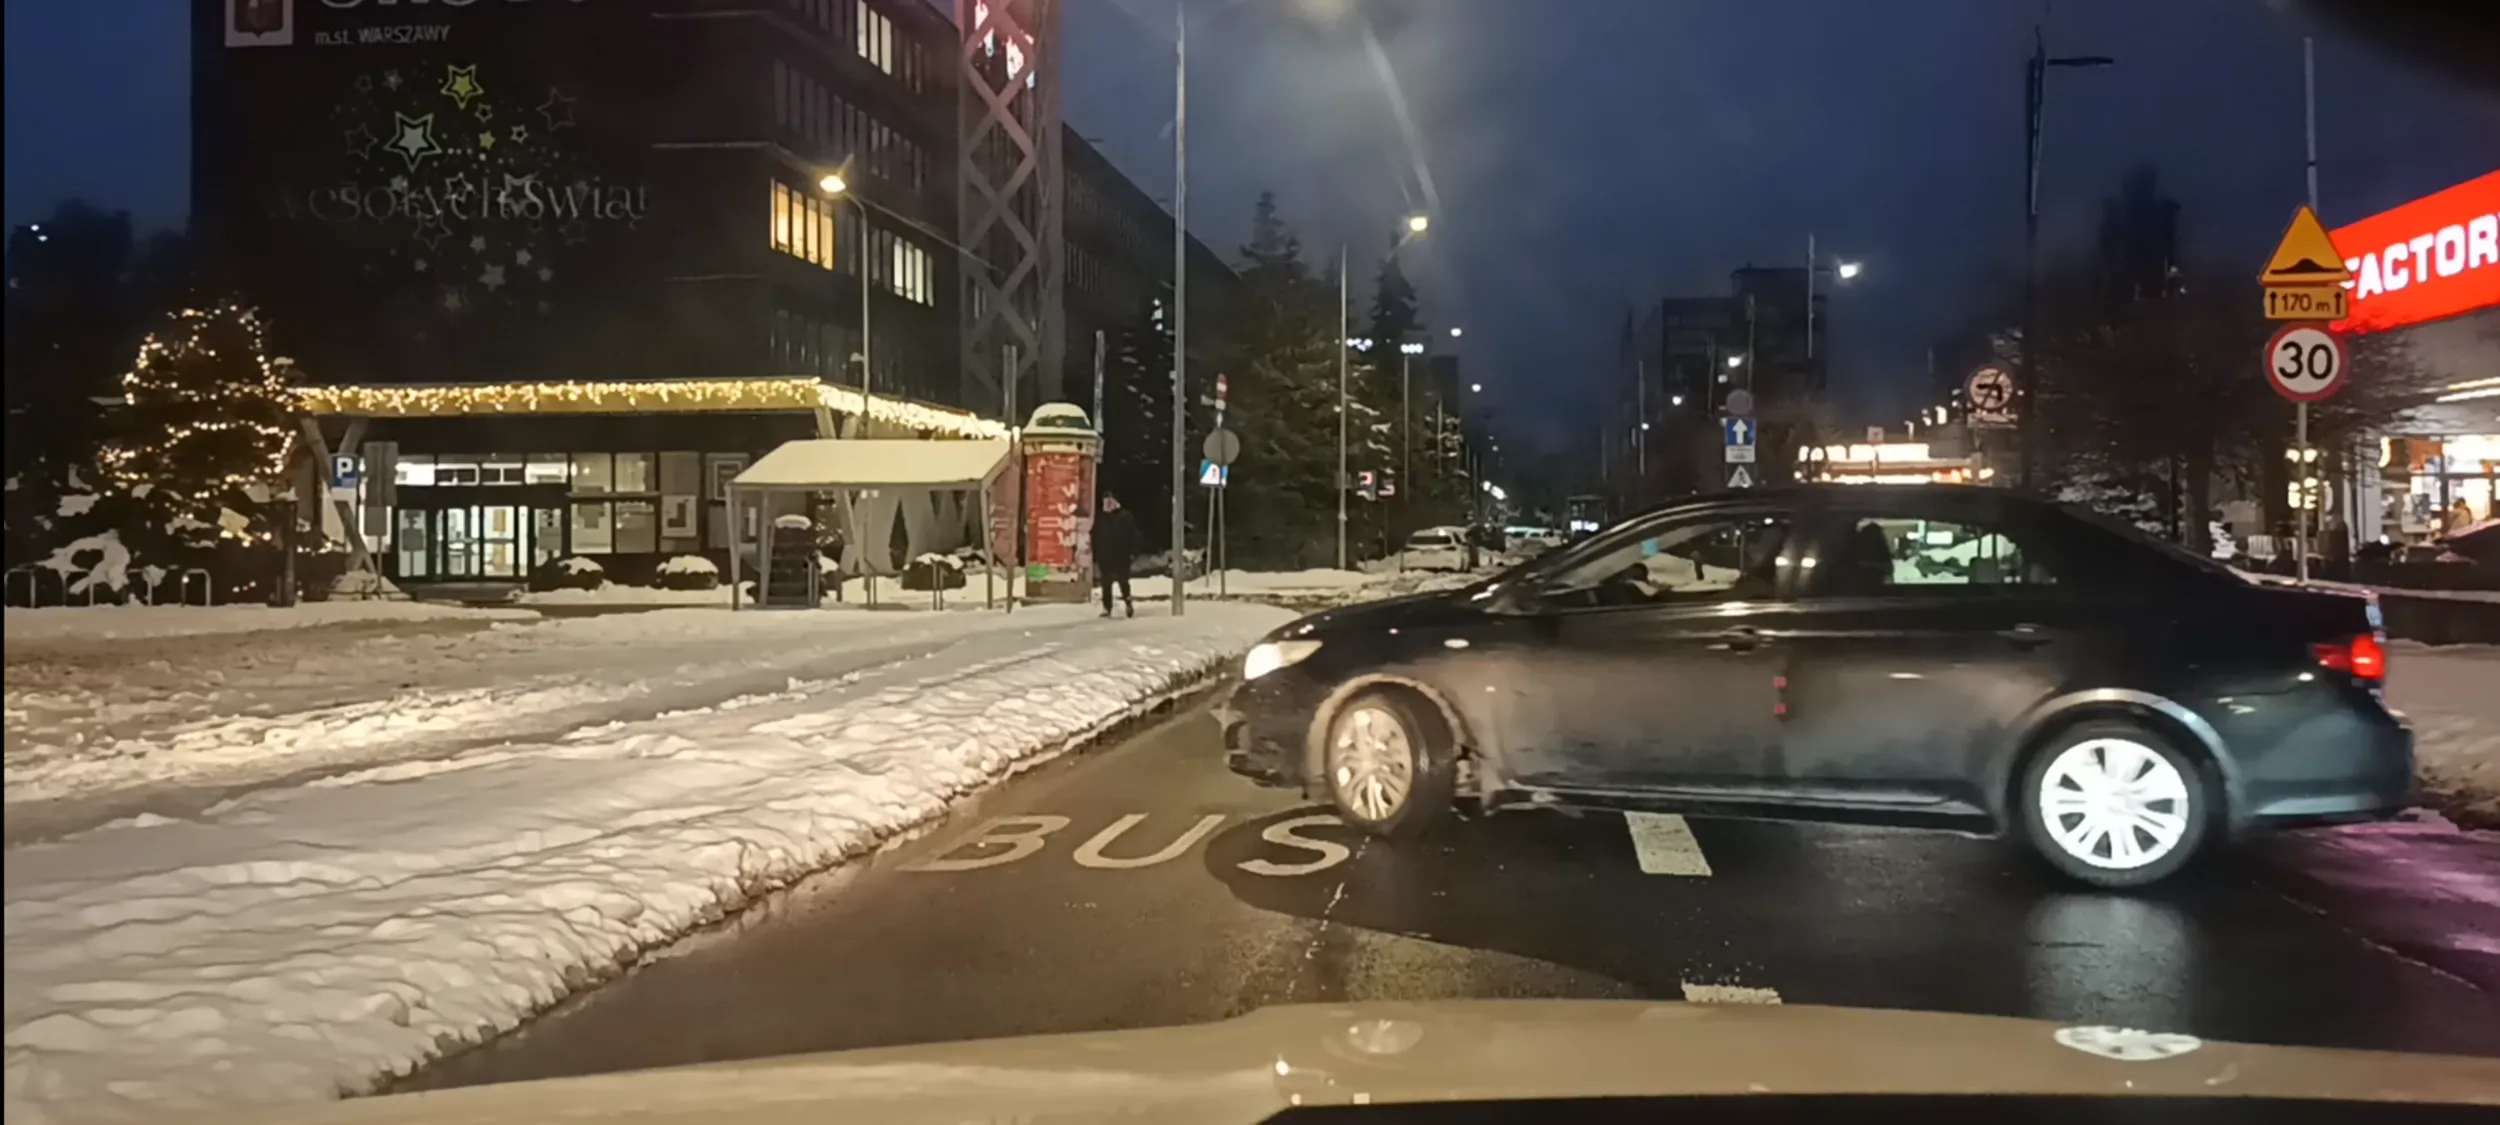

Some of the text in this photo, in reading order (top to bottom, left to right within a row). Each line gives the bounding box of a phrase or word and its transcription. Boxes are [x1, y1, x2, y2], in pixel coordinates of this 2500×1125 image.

[357, 23, 452, 44] WARSZAWY
[2281, 293, 2331, 313] 170 m
[2278, 340, 2334, 381] 30
[336, 456, 354, 479] P
[895, 813, 1352, 876] BUS
